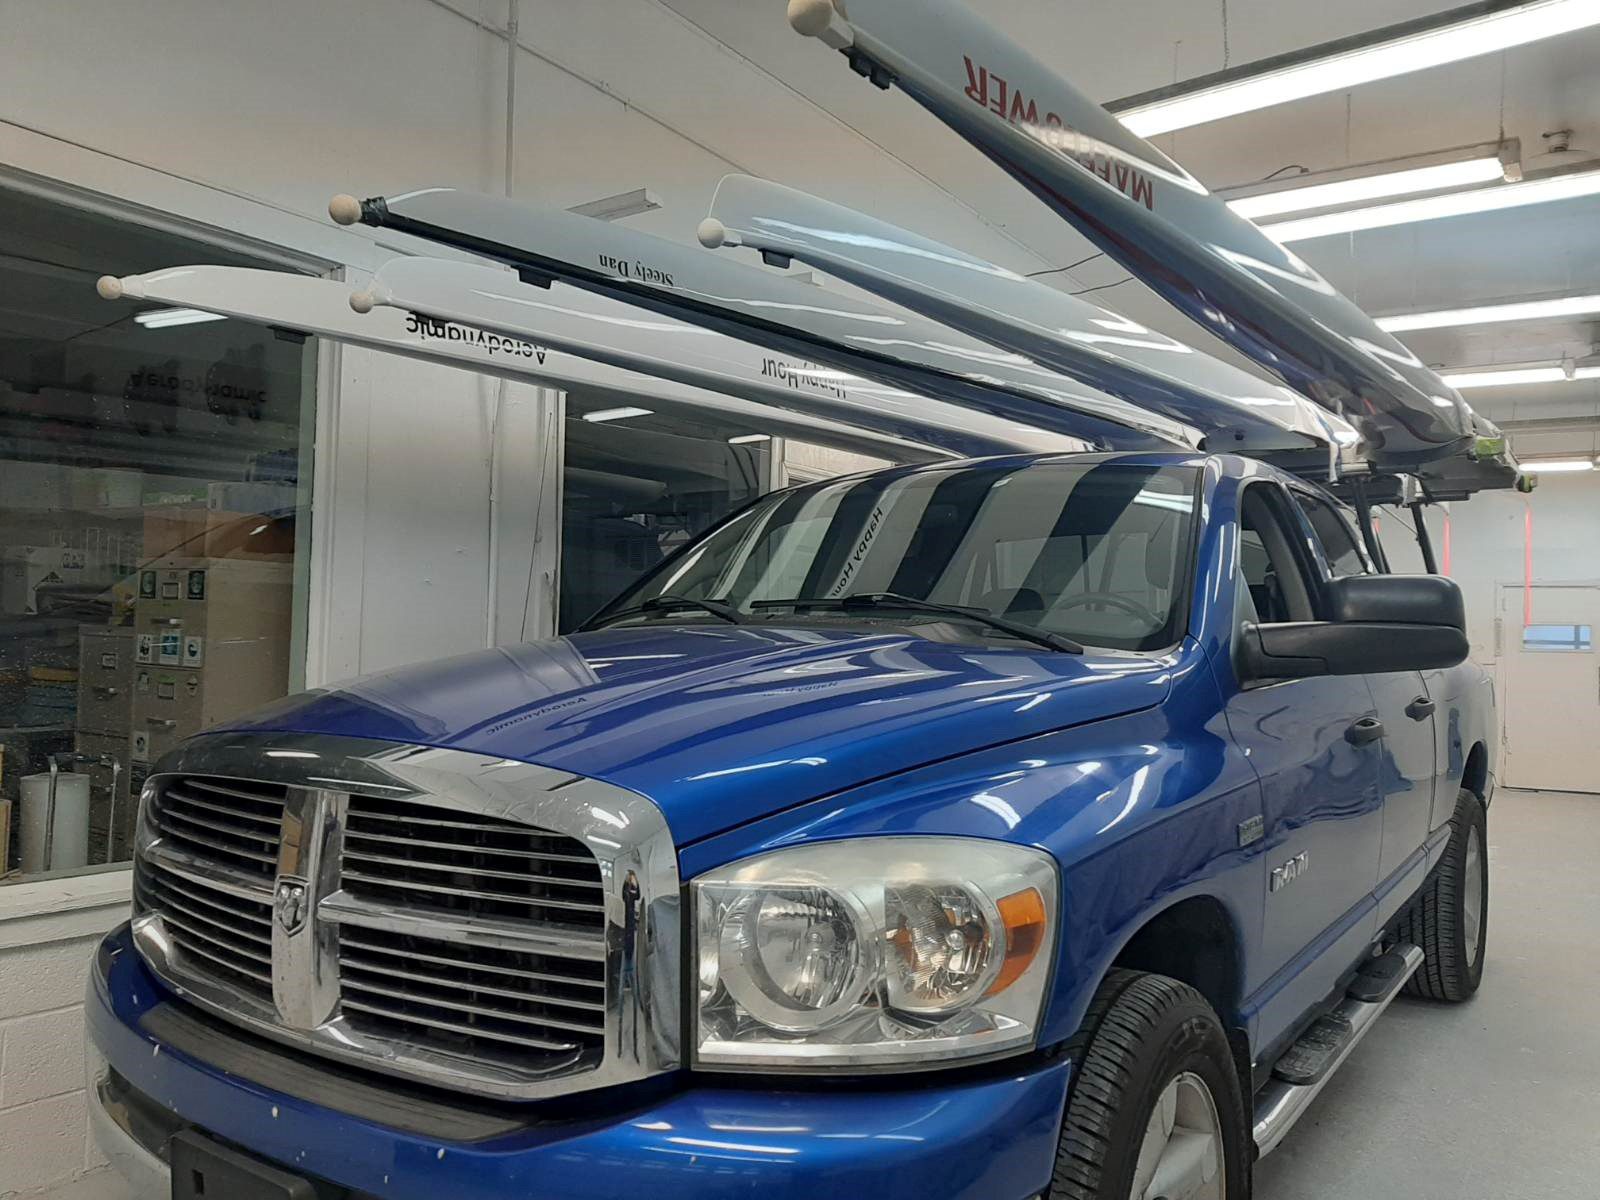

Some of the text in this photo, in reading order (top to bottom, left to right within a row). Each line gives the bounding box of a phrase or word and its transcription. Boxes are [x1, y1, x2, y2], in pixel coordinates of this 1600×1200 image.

[599, 253, 674, 287] Steely Dan
[405, 314, 548, 366] Aerodynamic
[761, 358, 799, 388] Hour
